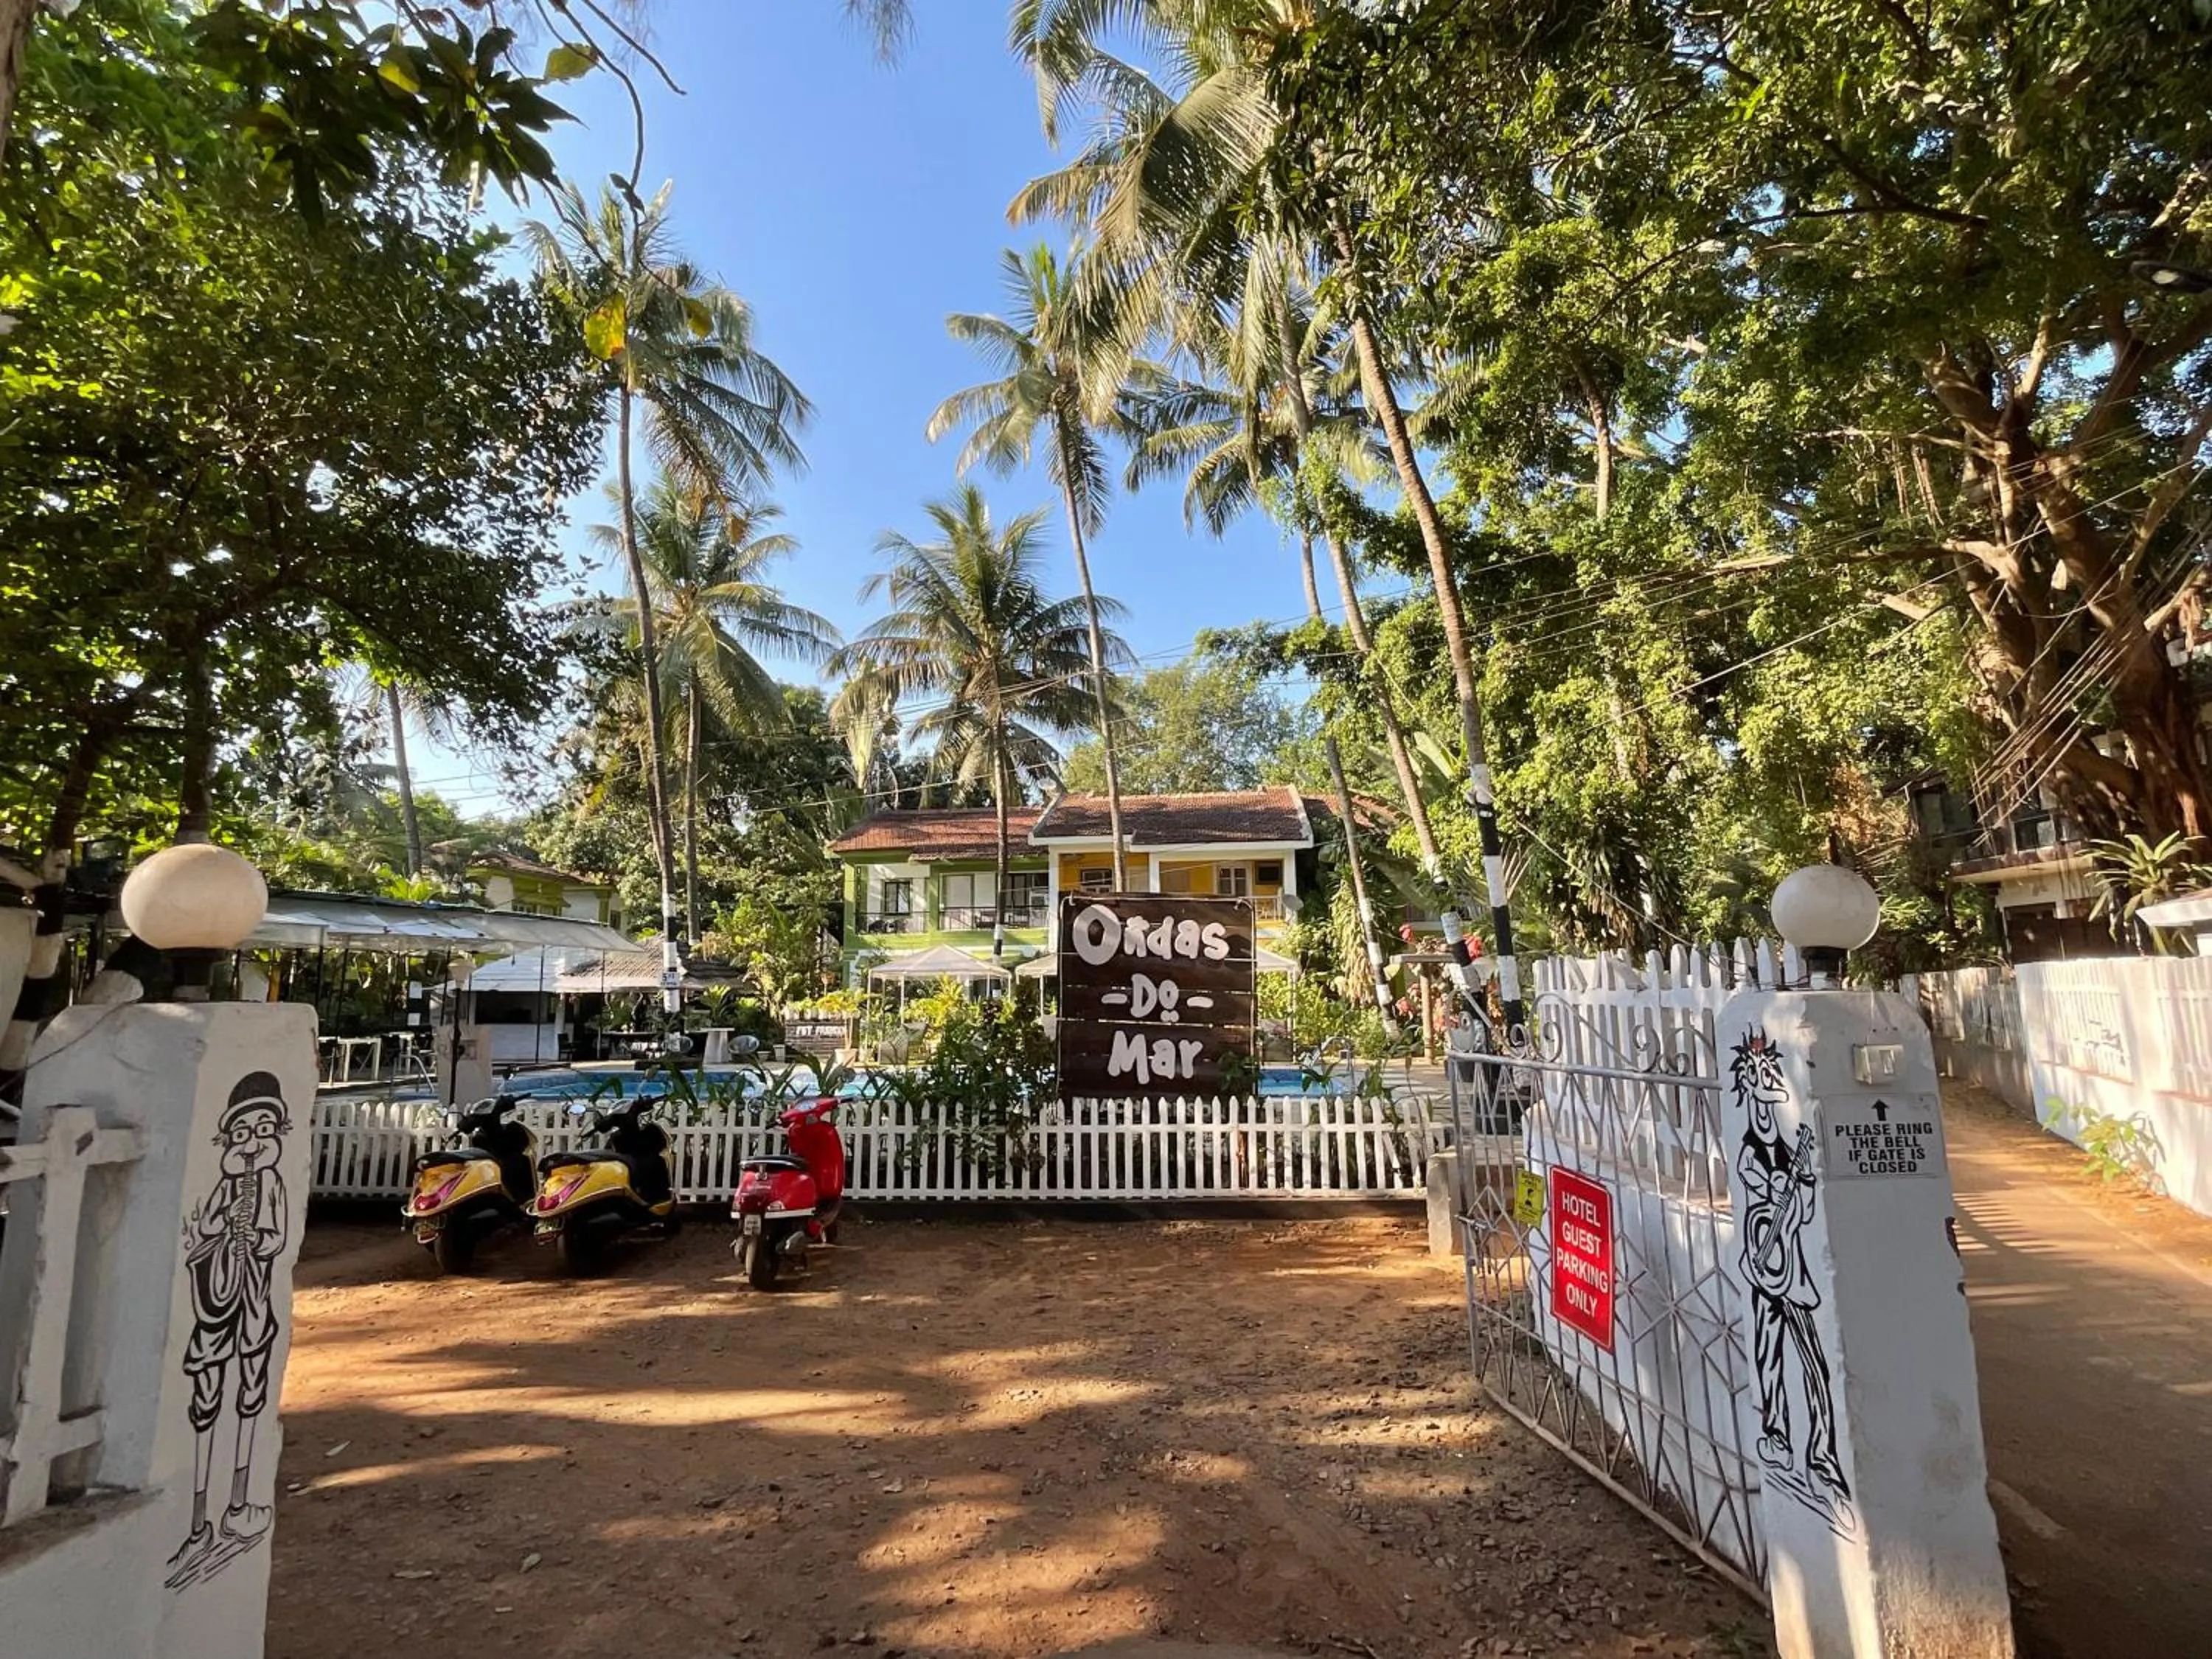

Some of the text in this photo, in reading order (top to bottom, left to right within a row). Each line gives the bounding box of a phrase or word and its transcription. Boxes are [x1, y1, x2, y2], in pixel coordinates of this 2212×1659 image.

[1072, 904, 1230, 965] Ondas
[1107, 1030, 1203, 1085] Mar
[1834, 1122, 1933, 1137] PLEASE RING
[1851, 1136, 1921, 1149] THE BELL
[1848, 1148, 1926, 1162] IF GATE IS
[1859, 1161, 1917, 1174] CLOSED
[1562, 1191, 1601, 1228] HOTEL
[1562, 1220, 1602, 1259] GUEST
[1557, 1247, 1608, 1293] PARKING
[1565, 1283, 1599, 1318] ONLY
